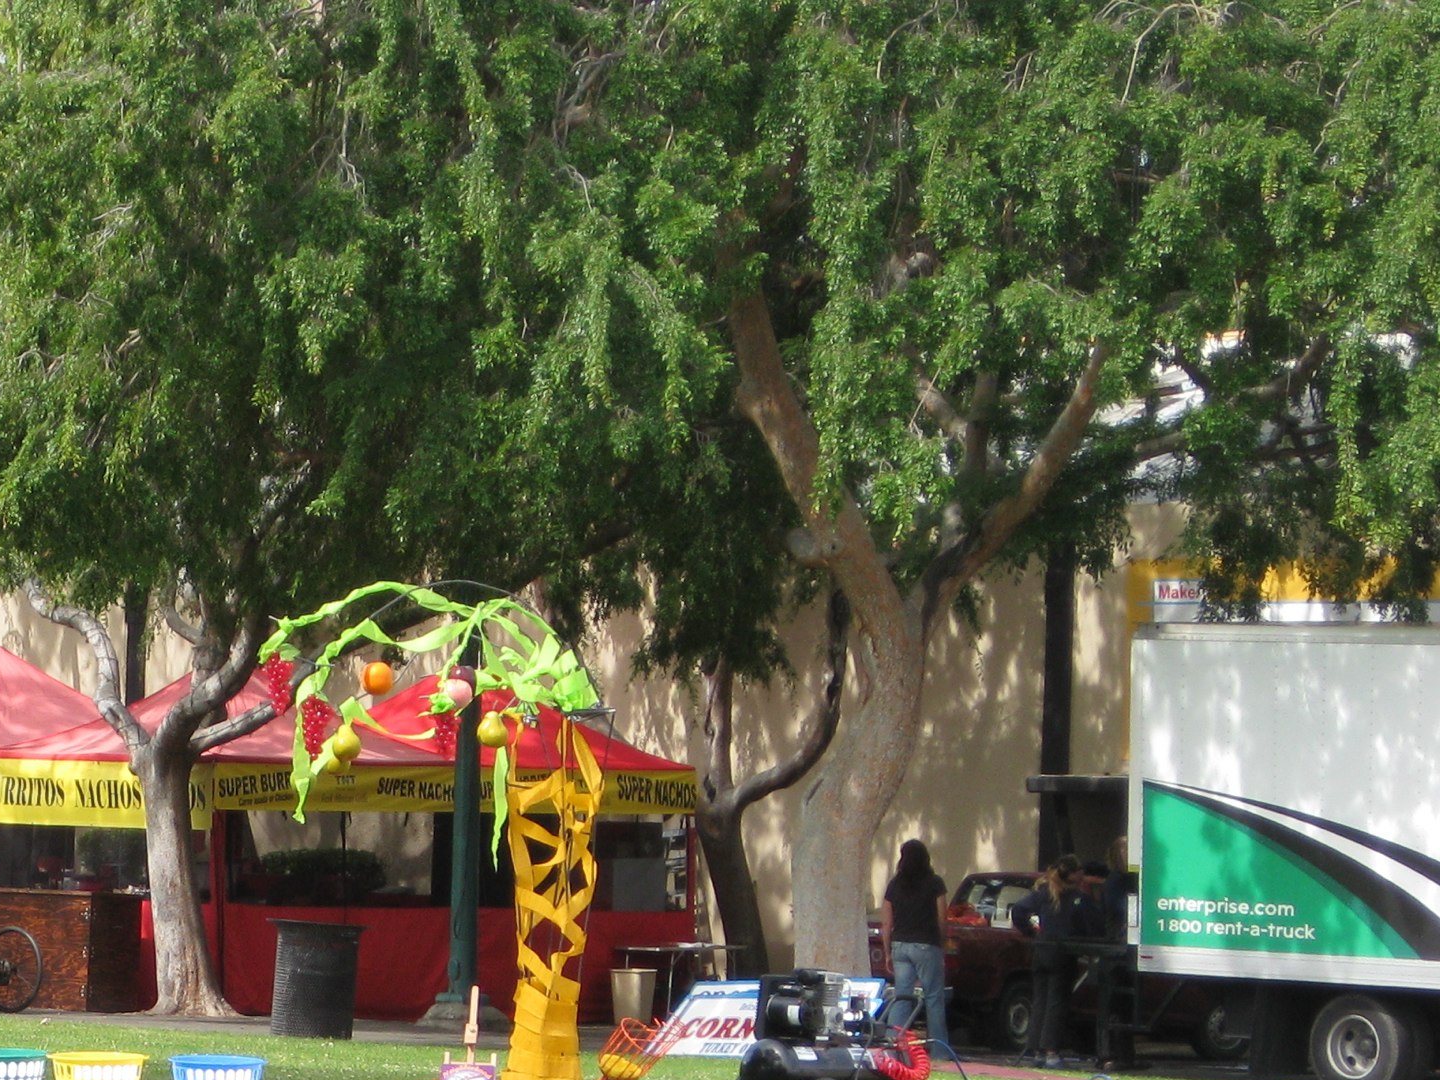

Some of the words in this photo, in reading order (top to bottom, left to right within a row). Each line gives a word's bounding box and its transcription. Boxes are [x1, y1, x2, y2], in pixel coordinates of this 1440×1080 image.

[75, 778, 142, 810] NACHOS
[218, 774, 258, 798] SUPER
[376, 776, 416, 799] SUPER
[419, 781, 455, 802] NACH
[617, 774, 652, 801] SUPER
[655, 781, 697, 810] NACHOS
[1157, 897, 1295, 917] enterprise.com
[1157, 919, 1164, 932] 1
[1168, 919, 1202, 934] 800
[1205, 921, 1316, 940] rent-a-truck
